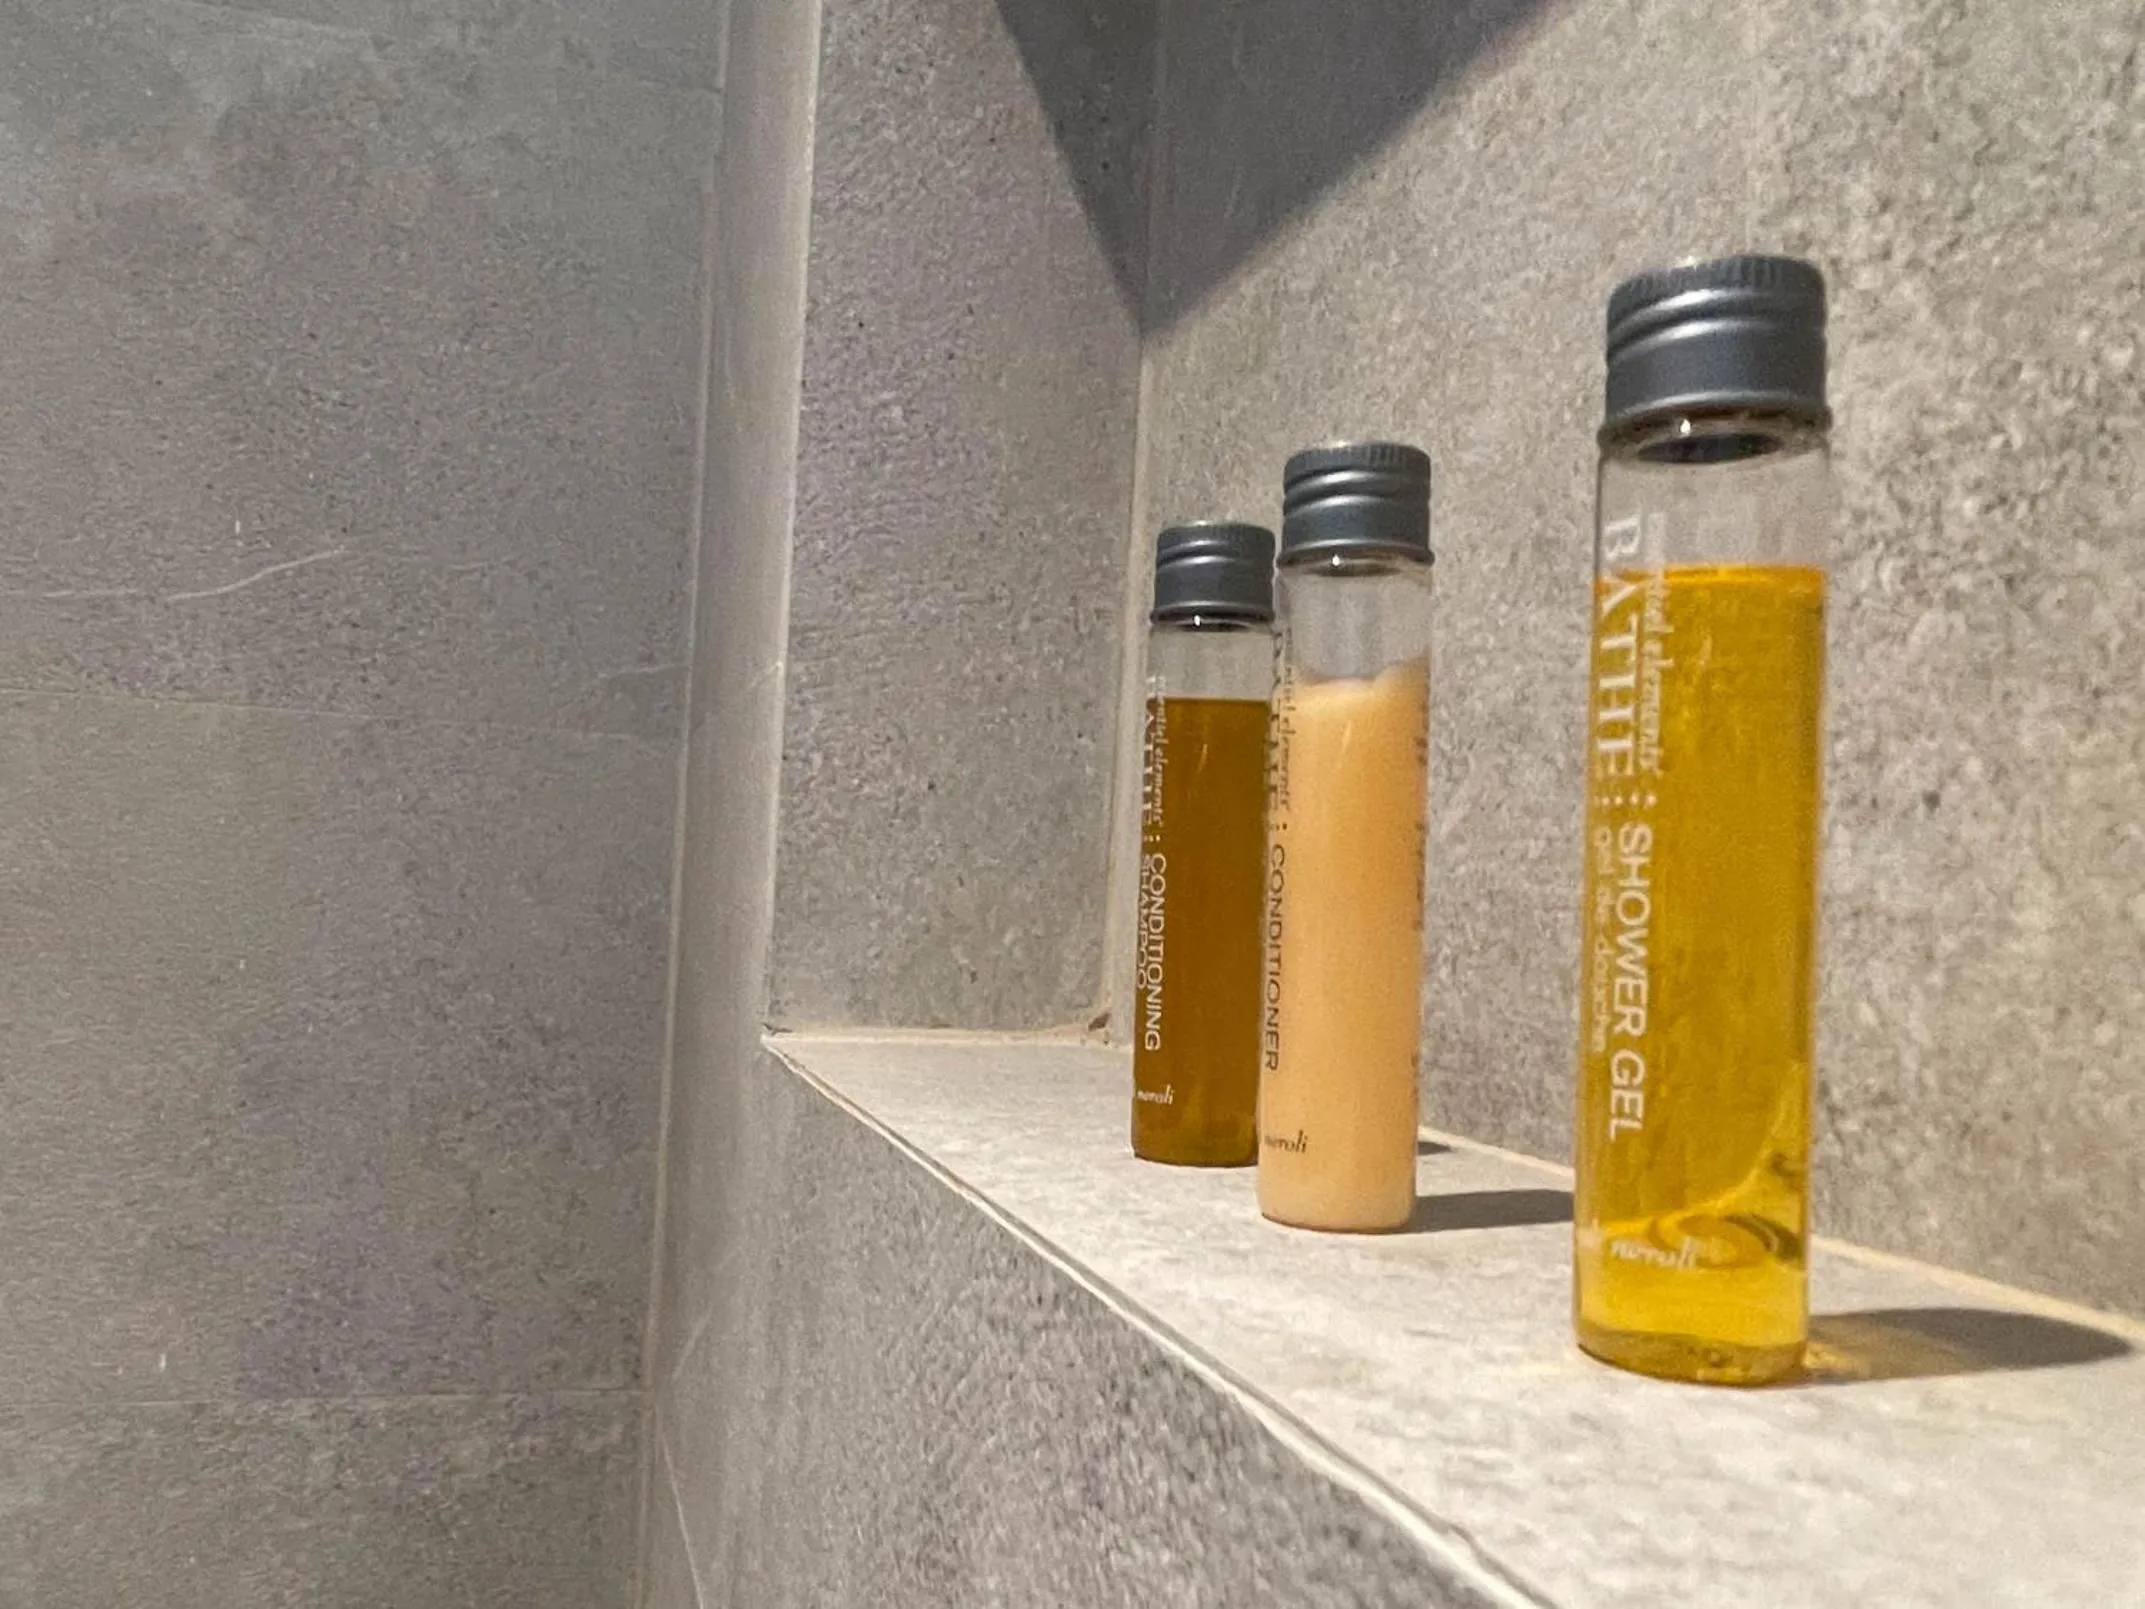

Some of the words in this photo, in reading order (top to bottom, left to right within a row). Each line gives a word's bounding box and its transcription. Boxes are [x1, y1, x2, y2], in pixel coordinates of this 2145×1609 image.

[1597, 513, 1642, 777] BATHE
[1144, 851, 1168, 1052] CONDITIONING
[1263, 843, 1286, 1073] CONDITIONER
[1613, 820, 1654, 1037] SHOWER
[1608, 1048, 1647, 1142] GEL
